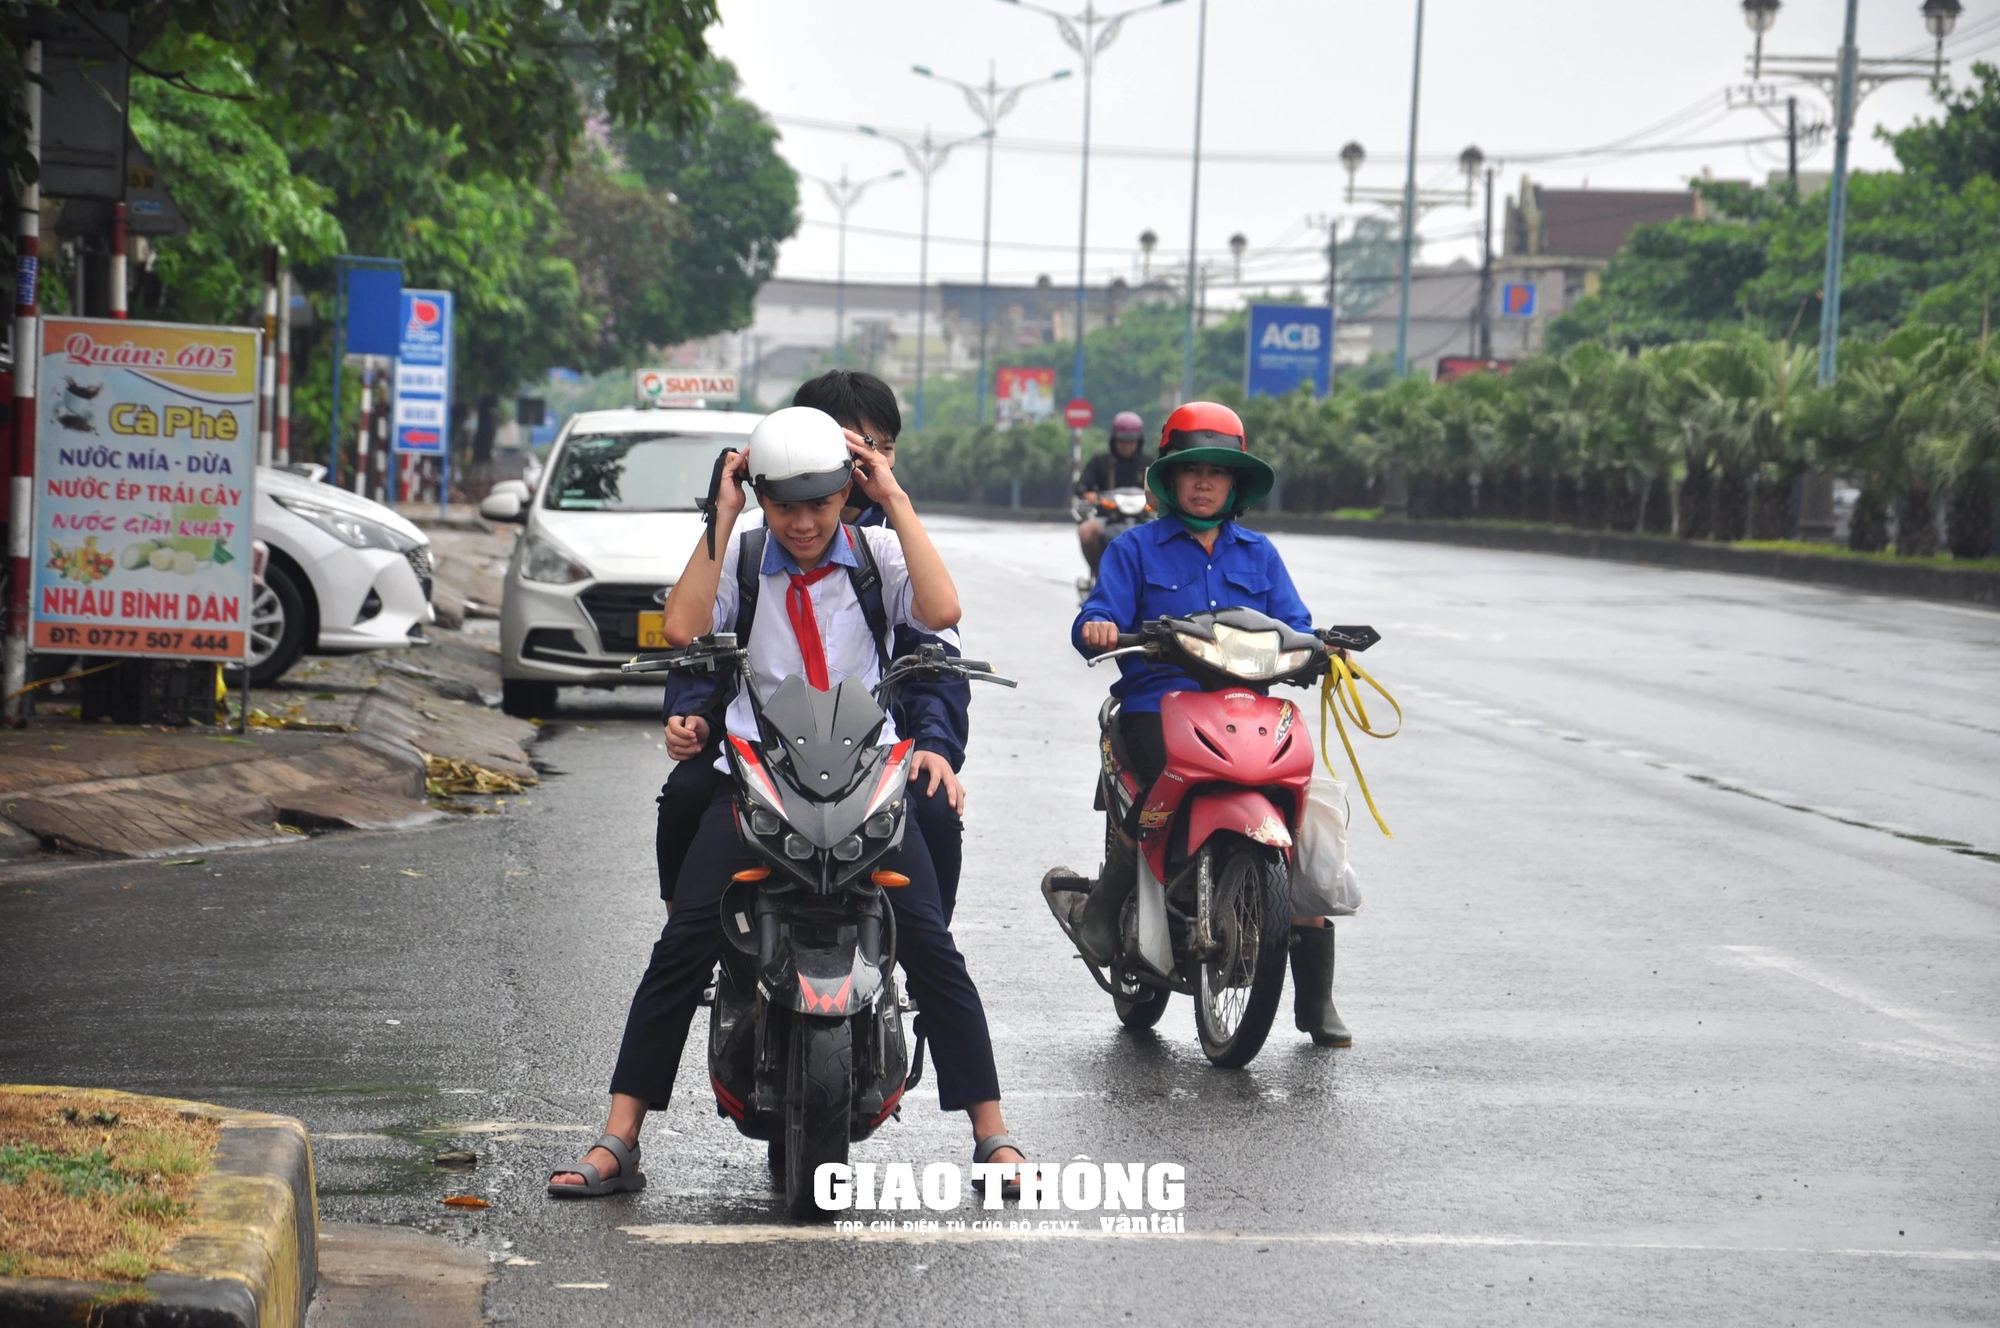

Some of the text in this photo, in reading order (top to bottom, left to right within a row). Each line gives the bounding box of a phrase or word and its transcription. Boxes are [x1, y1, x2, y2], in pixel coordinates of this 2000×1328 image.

[1260, 322, 1321, 350] ACB
[175, 343, 234, 369] 605
[701, 377, 735, 392] TAXI
[109, 403, 239, 440] Cà Phê
[126, 448, 170, 472] MÍA
[186, 451, 233, 475] DỪA
[116, 477, 142, 501] ÉP
[147, 481, 195, 504] TRÁI
[200, 484, 242, 507] CÂY
[123, 512, 173, 535] GIẢI
[178, 516, 236, 538] KHÁT
[121, 588, 180, 621] BÌNH
[186, 591, 240, 623] DÂN
[49, 626, 230, 651] ĐT: 0777 507 444
[1225, 693, 1256, 701] HONDA
